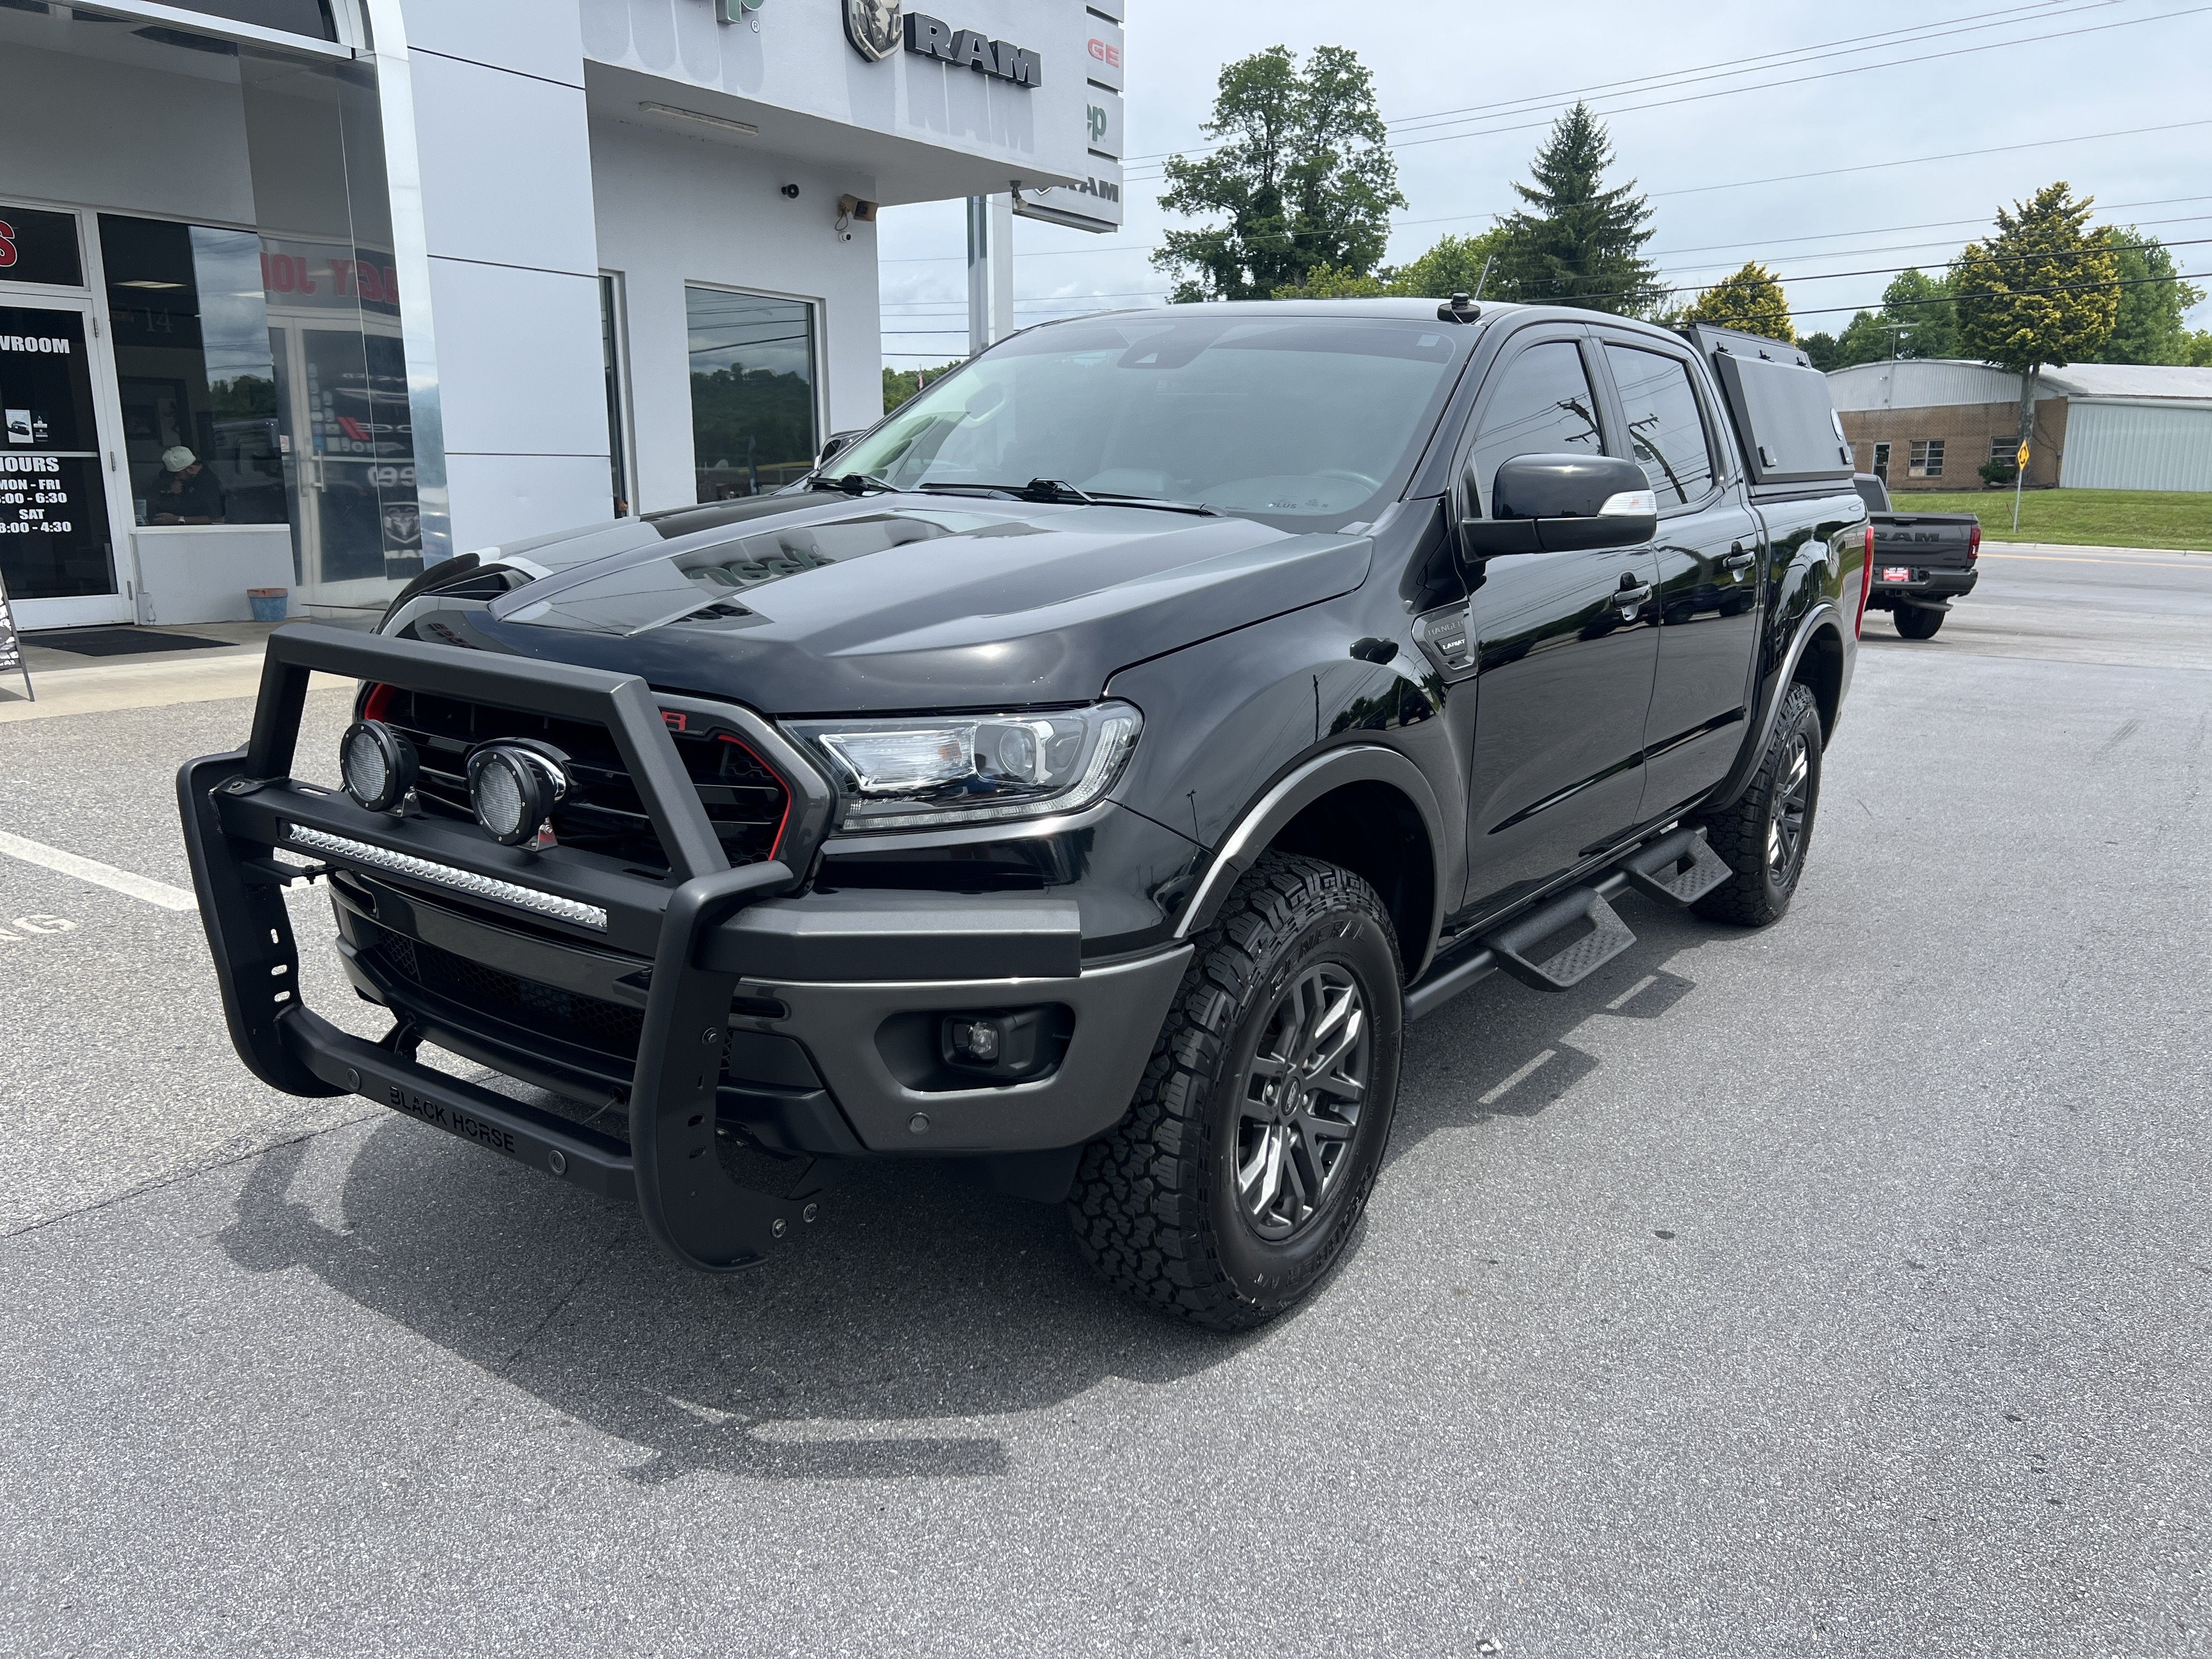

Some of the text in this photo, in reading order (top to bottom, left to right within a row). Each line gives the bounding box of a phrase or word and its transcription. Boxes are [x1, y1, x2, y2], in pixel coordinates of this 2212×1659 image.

[904, 12, 1041, 88] RAM
[38, 479, 61, 490] FRI
[0, 493, 25, 504] :00
[35, 492, 67, 504] 6:30
[19, 509, 45, 520] SAT
[40, 521, 72, 533] 4:30
[1874, 532, 1940, 543] RAM
[1427, 620, 1464, 636] RANGER
[1442, 639, 1465, 650] LARIAT
[1269, 918, 1365, 999] GENERAL
[389, 1086, 516, 1154] BLACK HORSE
